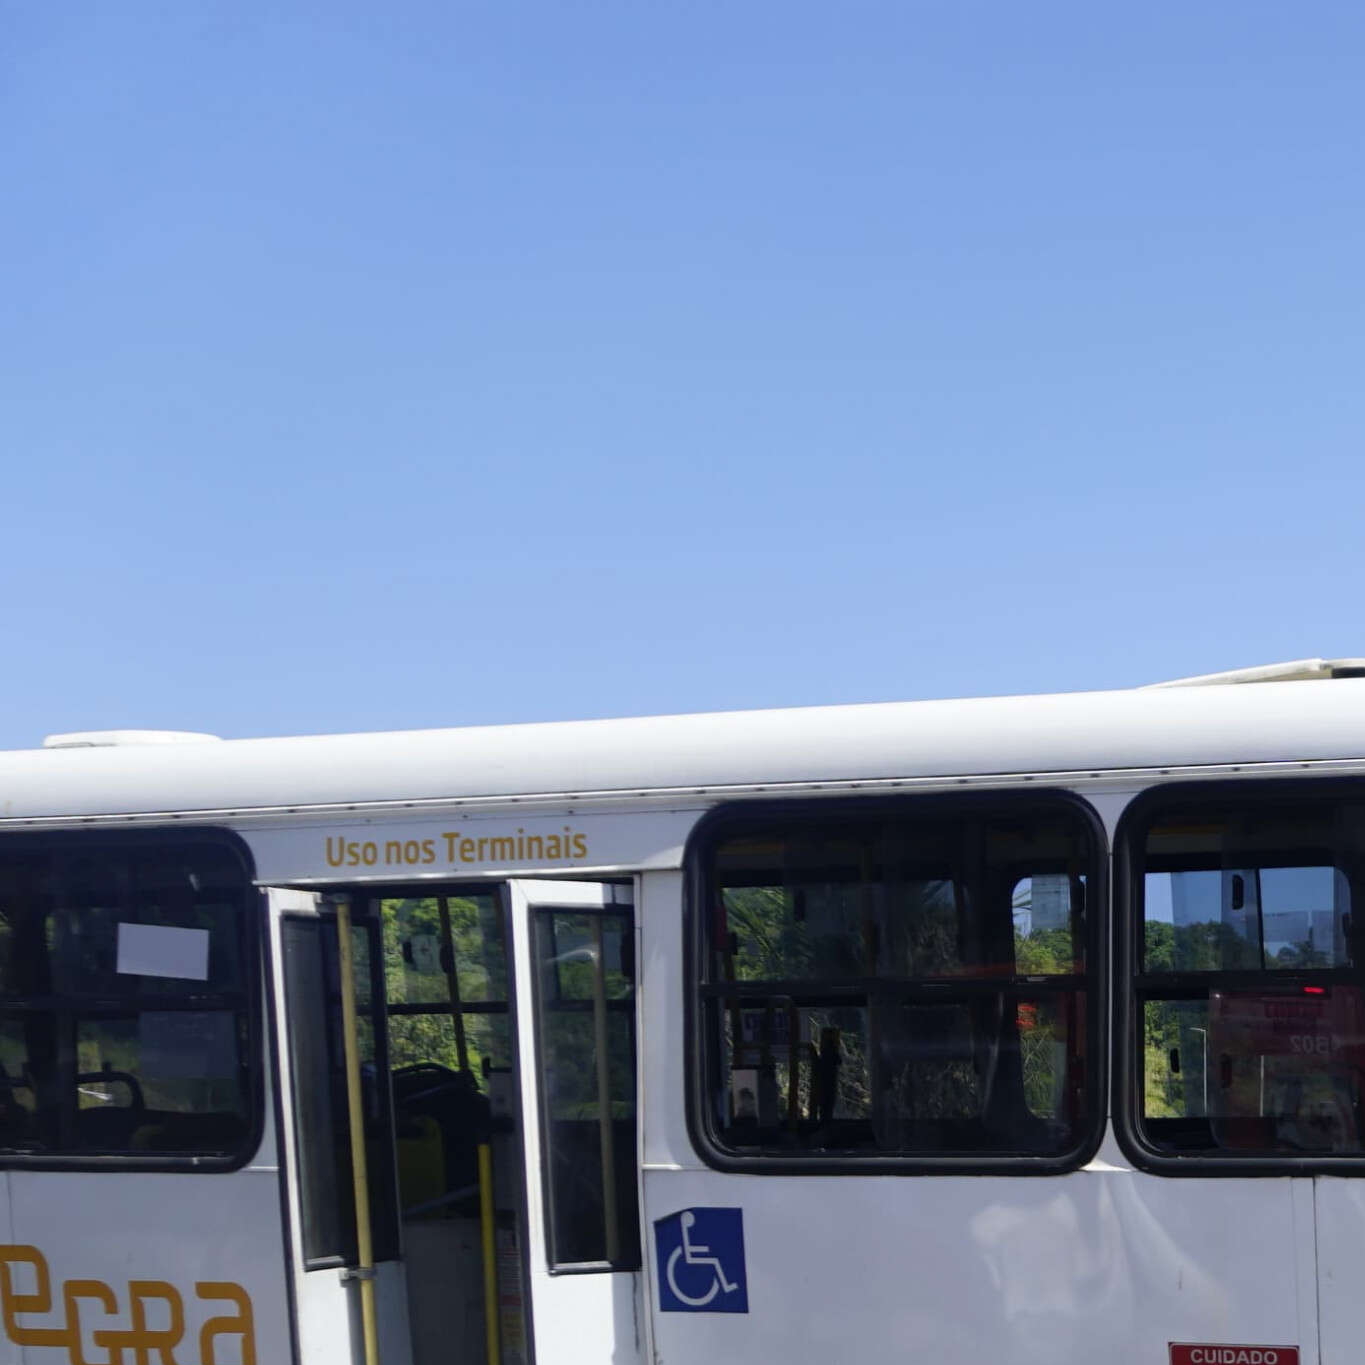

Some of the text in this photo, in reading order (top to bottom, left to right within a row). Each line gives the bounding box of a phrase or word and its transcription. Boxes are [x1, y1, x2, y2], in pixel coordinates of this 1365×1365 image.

[325, 825, 588, 867] Uso nos Terminais
[1190, 1348, 1278, 1365] CUIDADO
